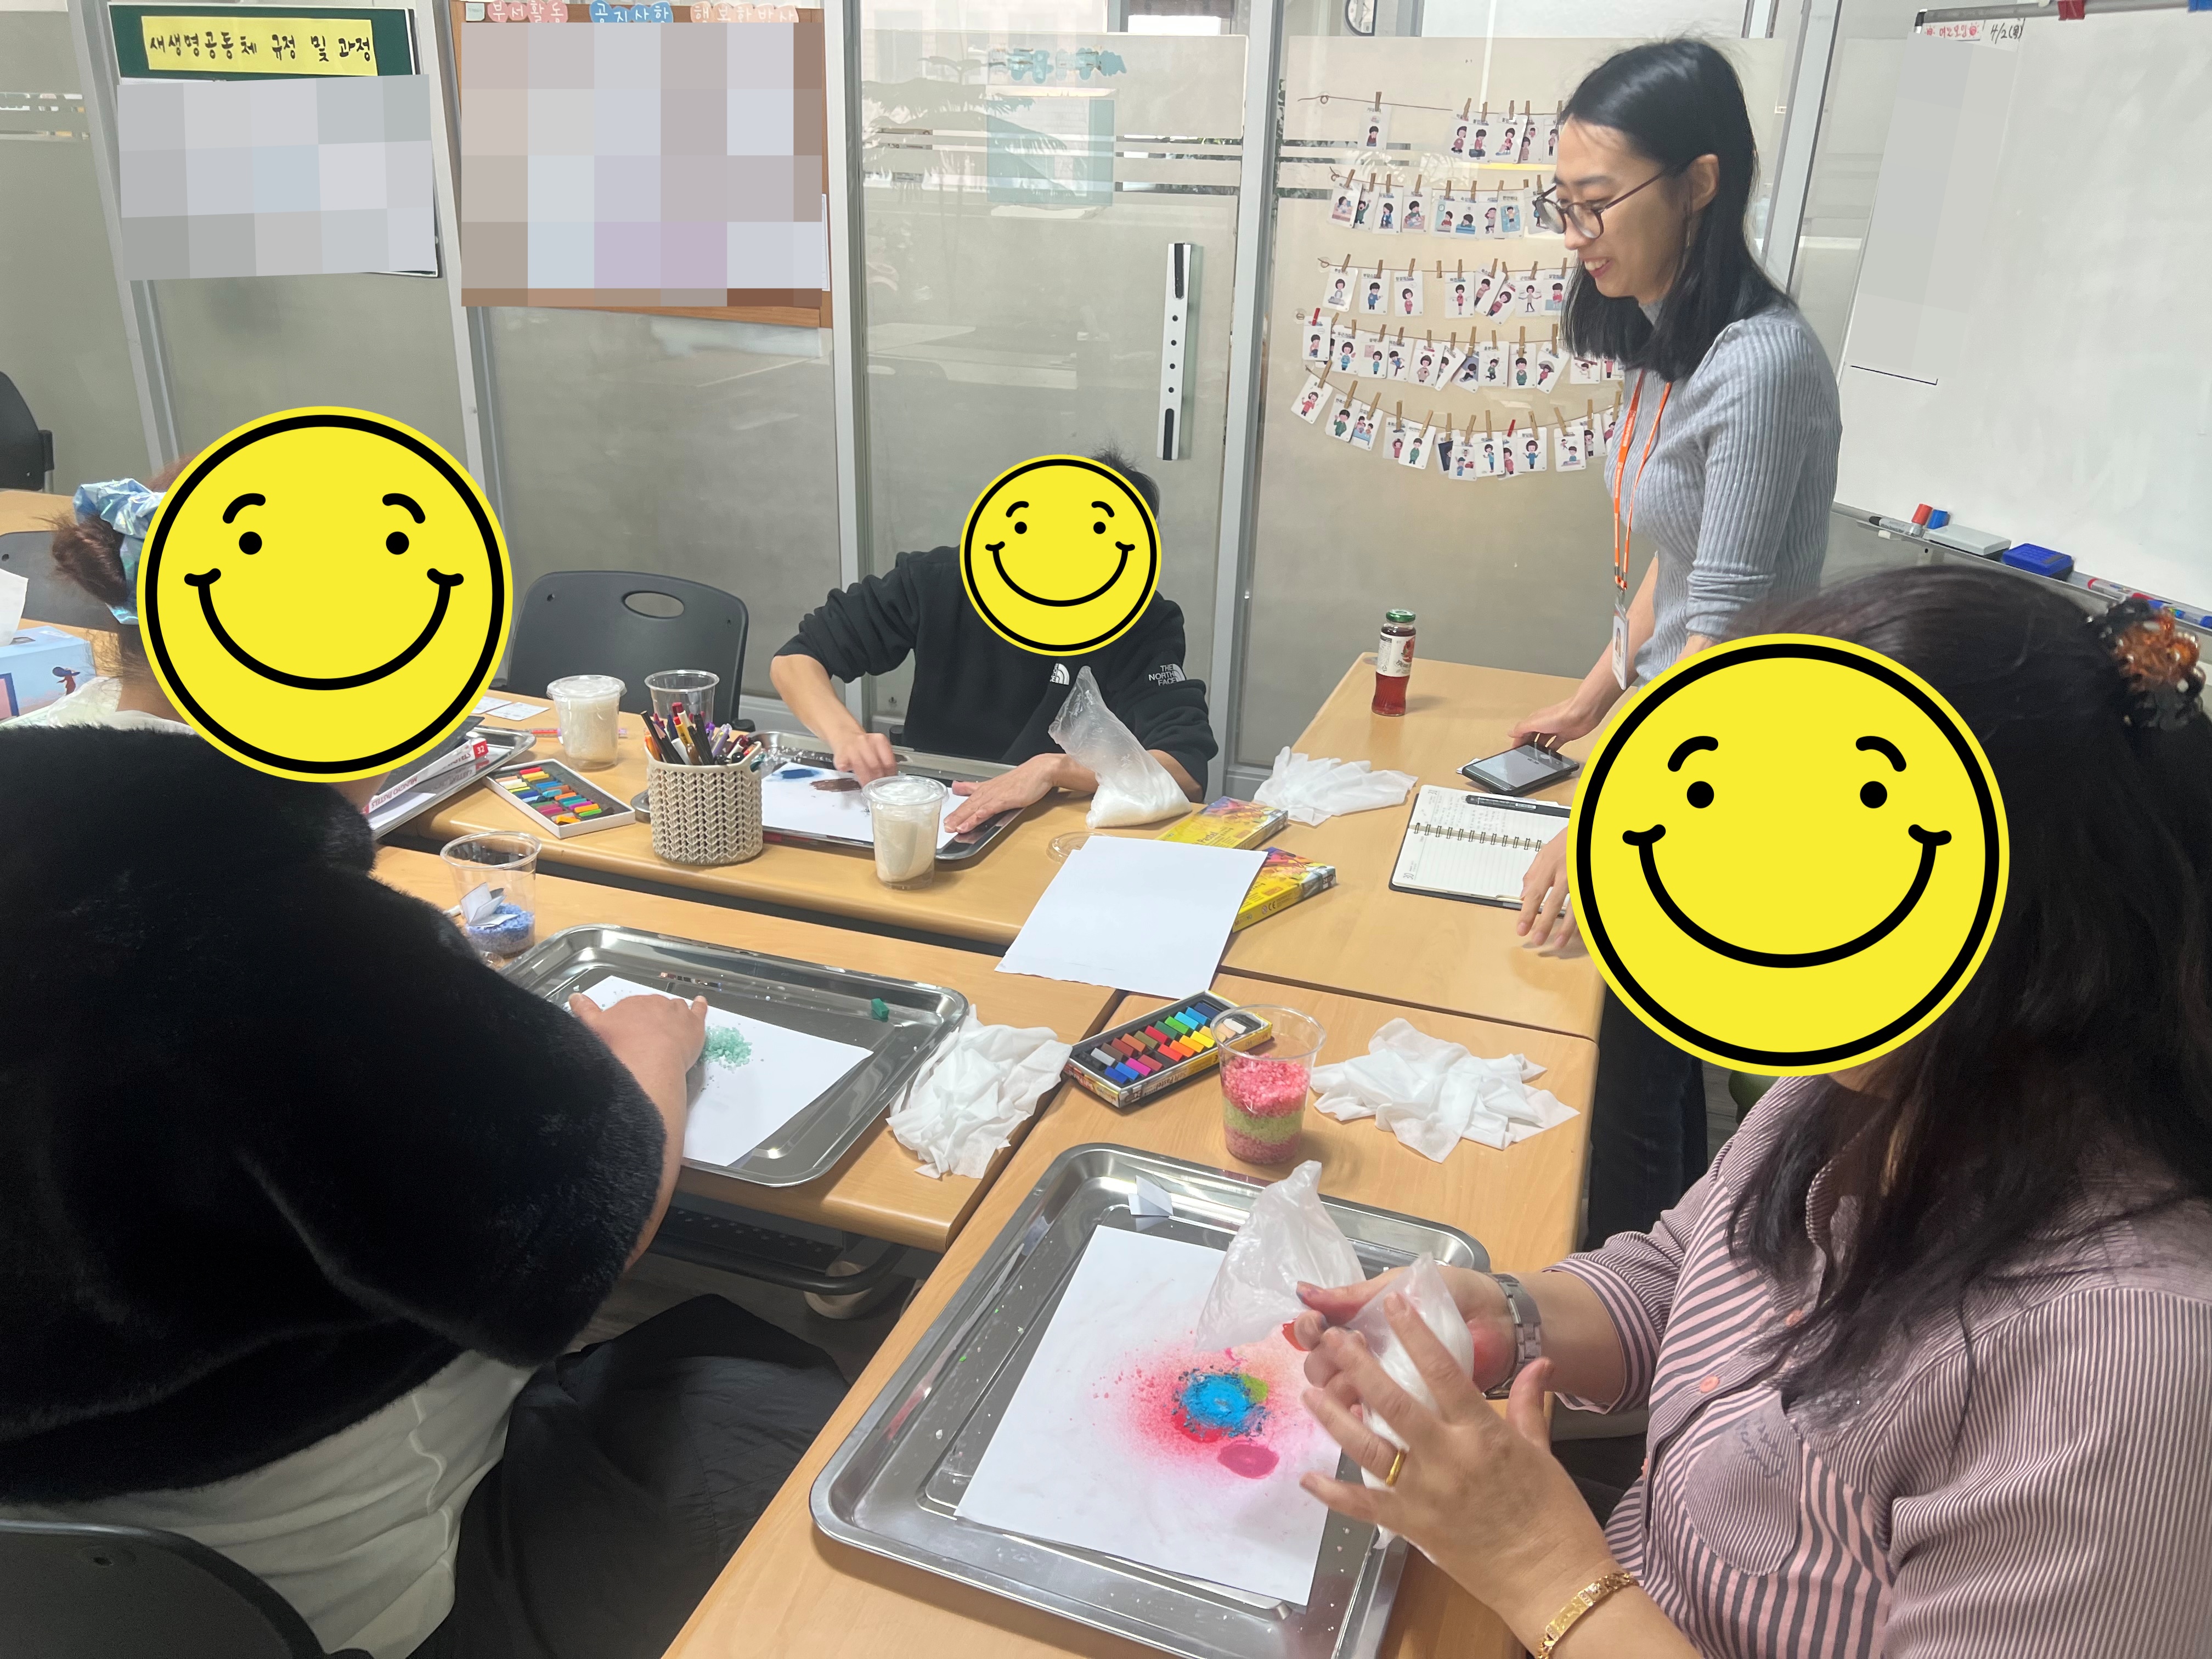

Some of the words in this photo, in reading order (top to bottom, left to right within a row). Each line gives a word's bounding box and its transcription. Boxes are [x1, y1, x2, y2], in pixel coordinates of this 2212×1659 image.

[150, 31, 257, 59] 새생명공동체
[271, 35, 296, 60] 규정
[311, 36, 329, 61] 및
[338, 37, 371, 62] 과정
[1148, 671, 1175, 681] NORTH
[1158, 677, 1176, 686] FACE
[477, 745, 485, 754] 32
[393, 776, 418, 796] MUNGYO
[371, 791, 393, 809] PASTELS
[1155, 1076, 1175, 1091] Pastel
